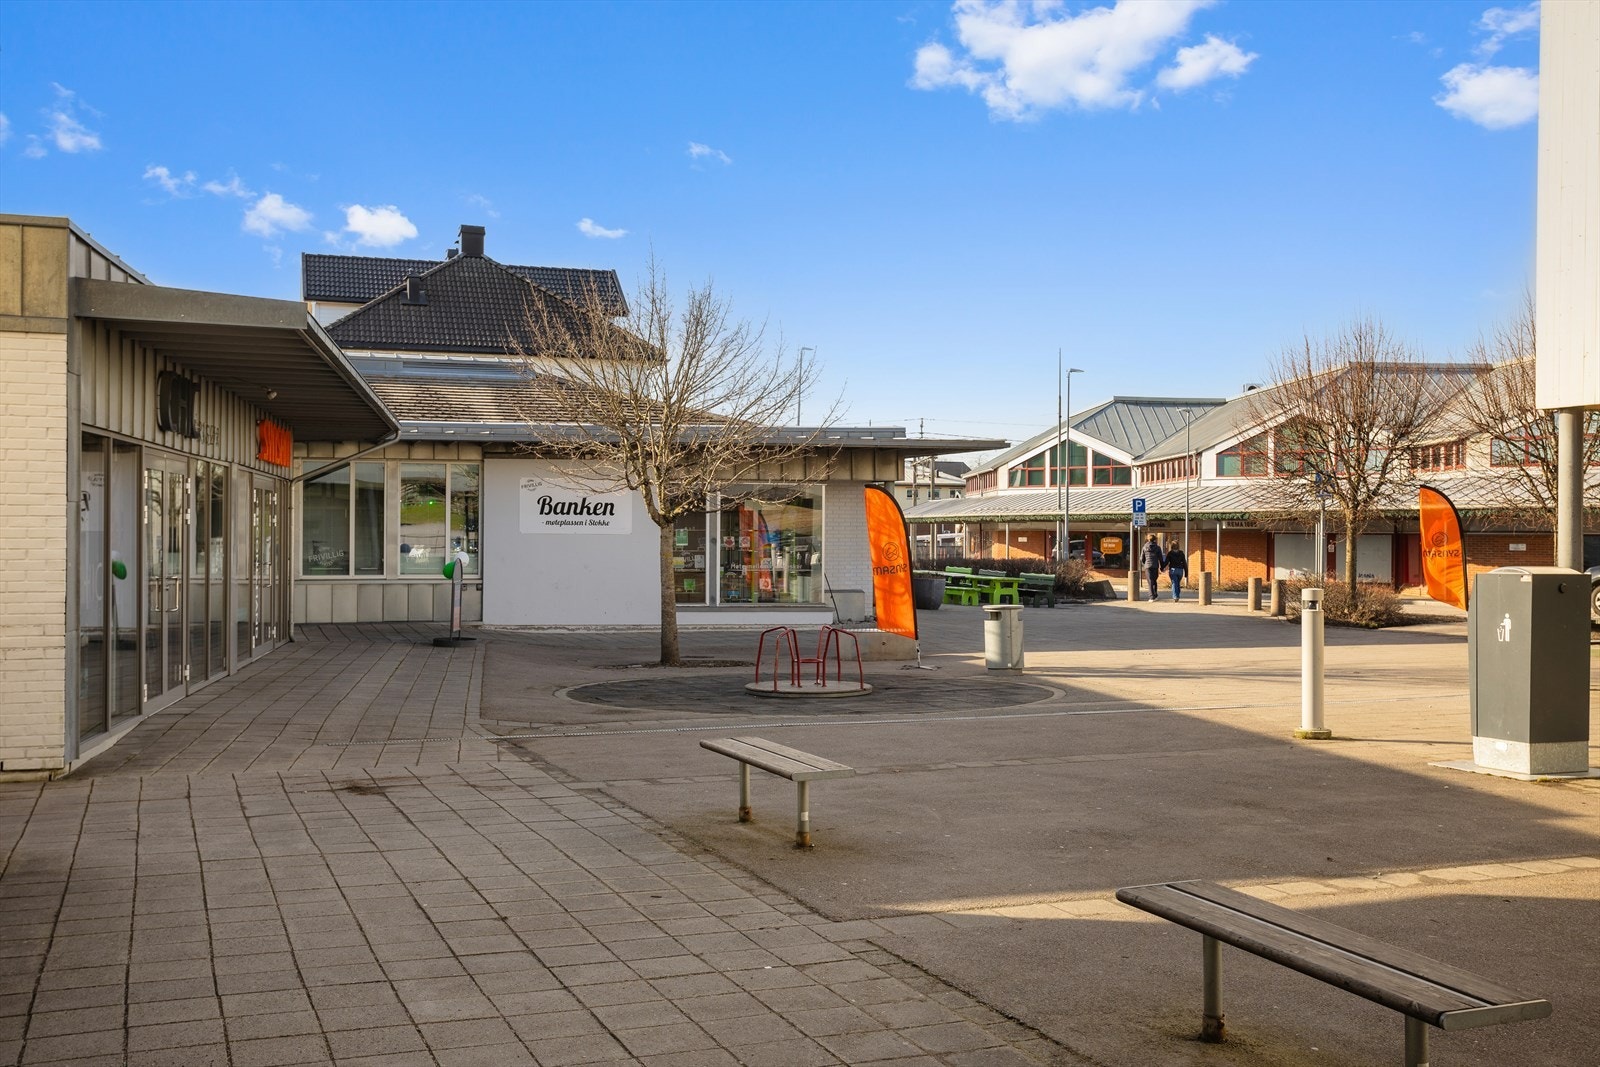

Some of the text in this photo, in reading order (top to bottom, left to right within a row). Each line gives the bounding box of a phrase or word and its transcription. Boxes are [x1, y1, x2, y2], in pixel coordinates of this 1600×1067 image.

[521, 481, 542, 489] FRIVILLIG
[537, 495, 615, 516] Banken
[1135, 500, 1143, 511] P
[545, 519, 584, 527] møteplassen
[308, 550, 345, 562] FRIVILLIG
